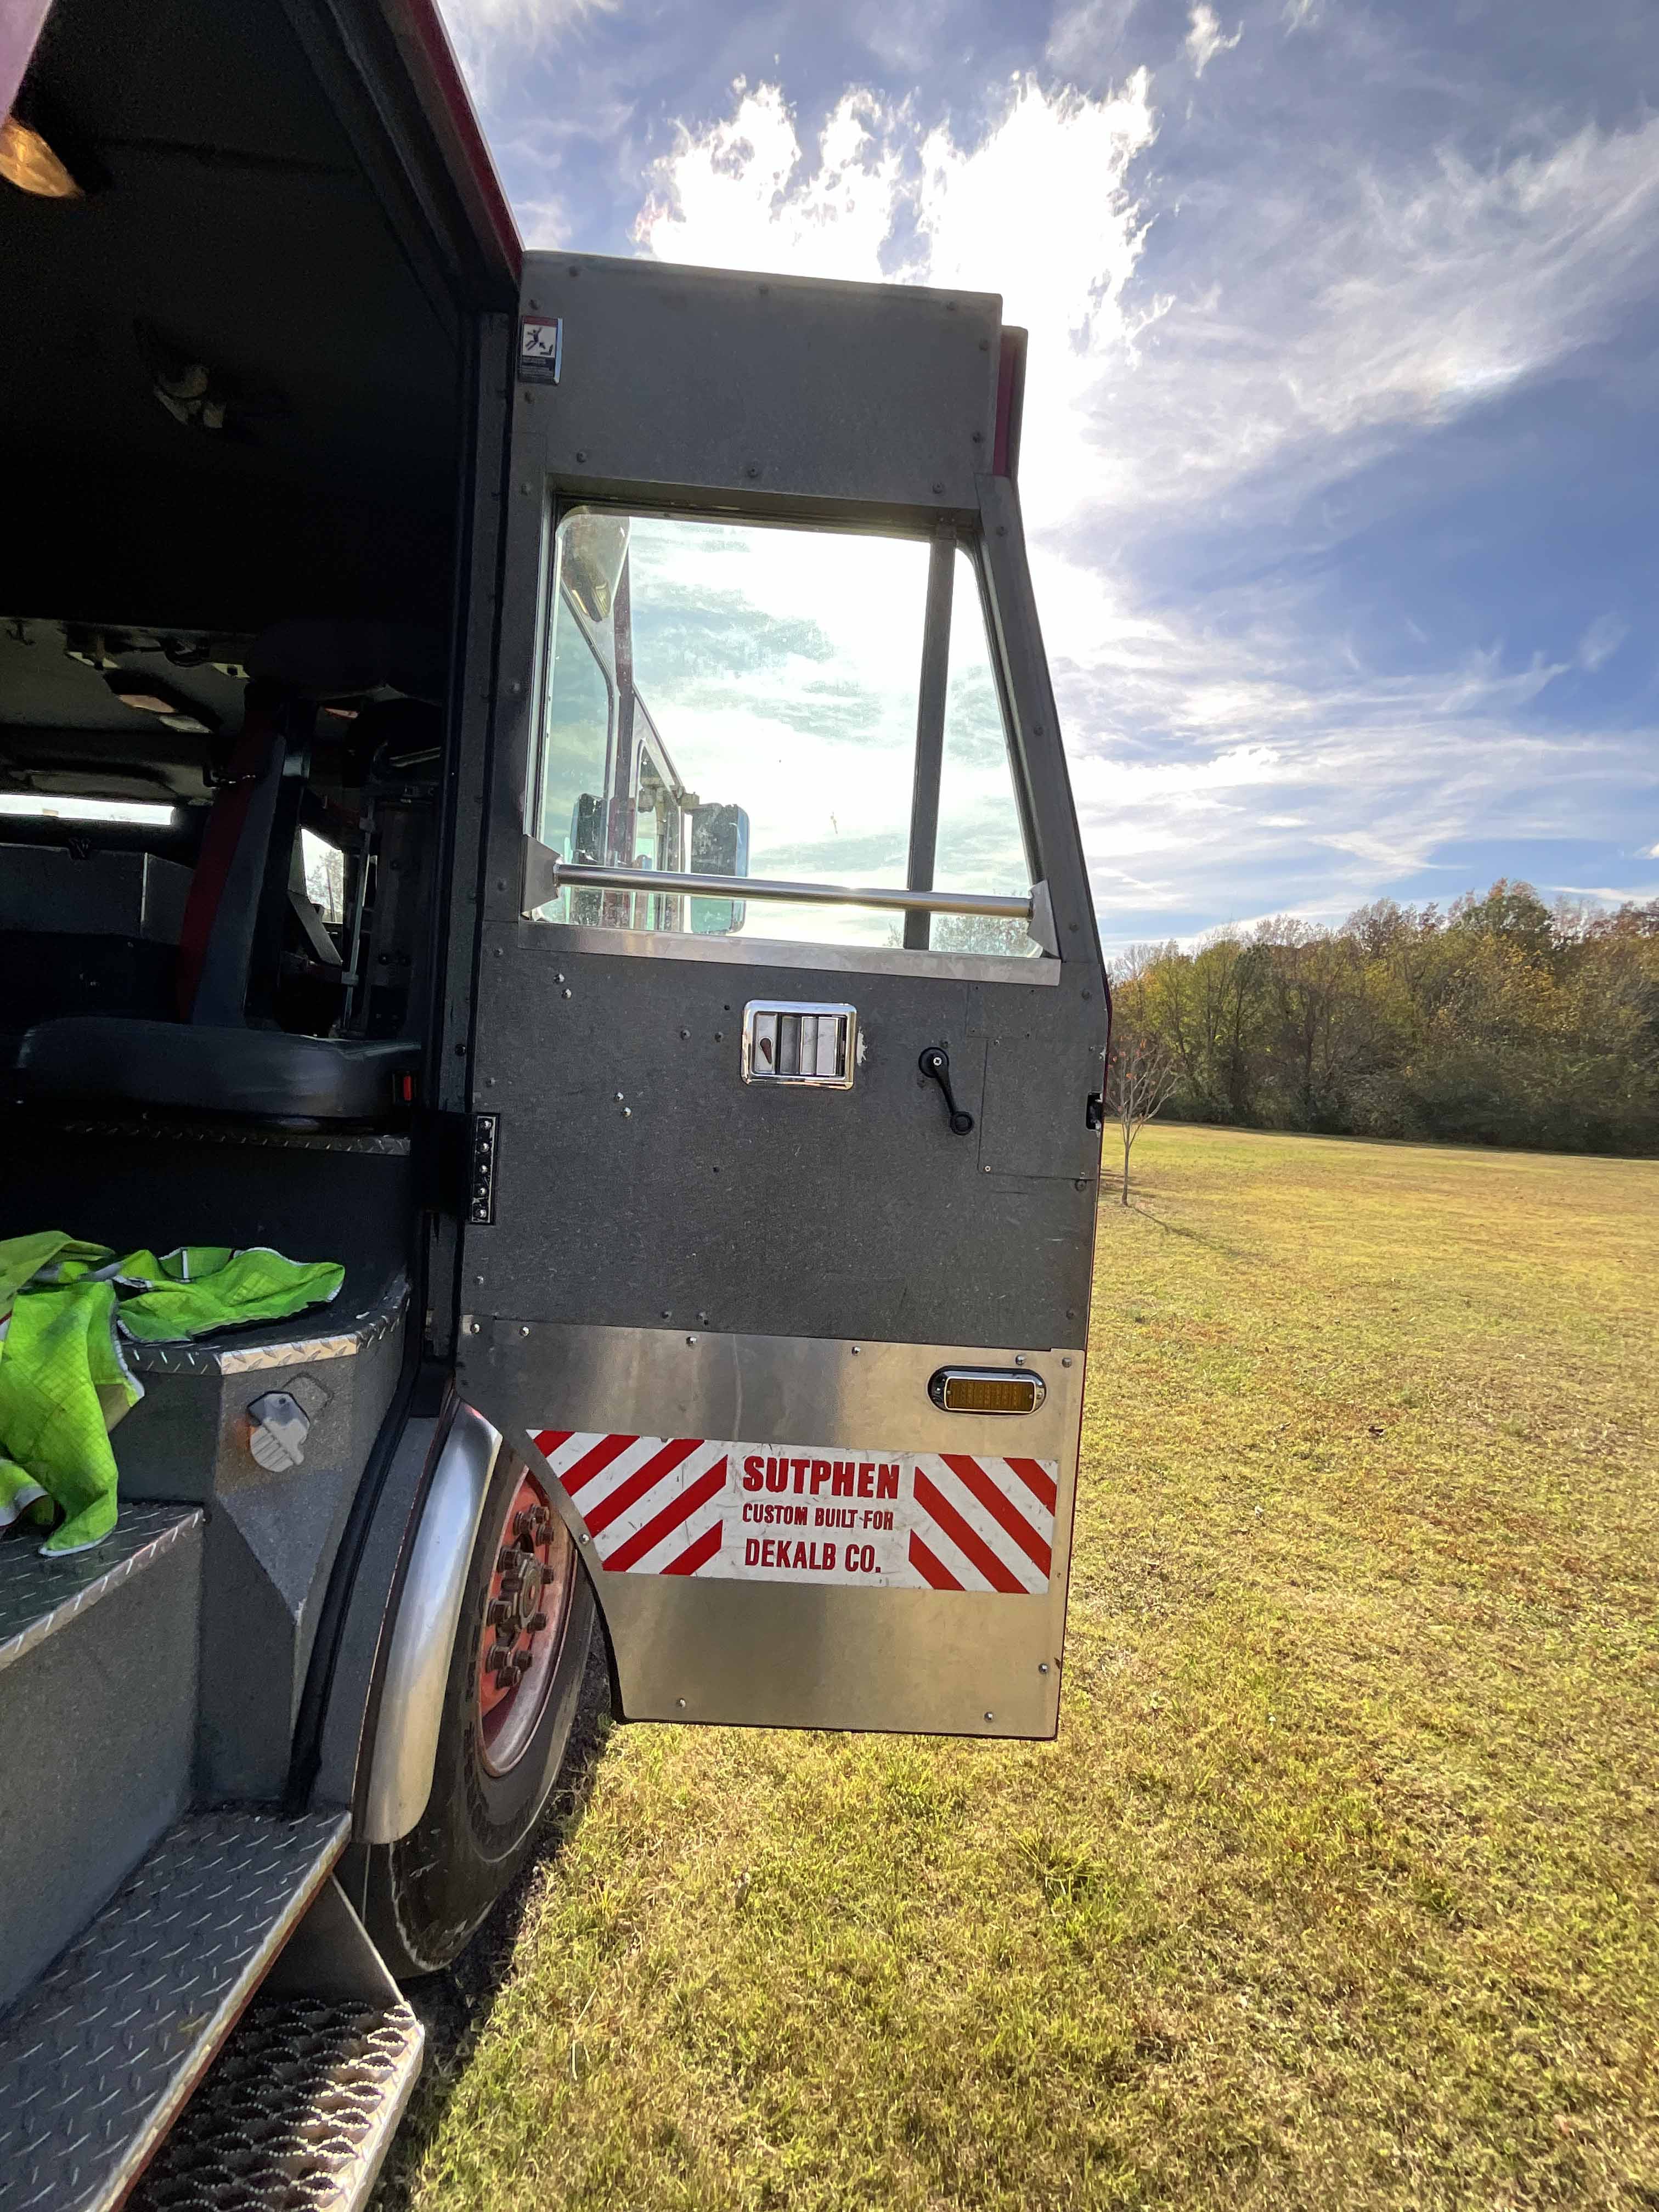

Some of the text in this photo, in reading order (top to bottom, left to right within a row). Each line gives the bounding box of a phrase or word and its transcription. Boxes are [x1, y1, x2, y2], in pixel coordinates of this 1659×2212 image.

[743, 1455, 900, 1499] SUTPHEN
[742, 1503, 894, 1531] CUSTOM BUILT FOR
[745, 1538, 881, 1573] DEKALB CO.
